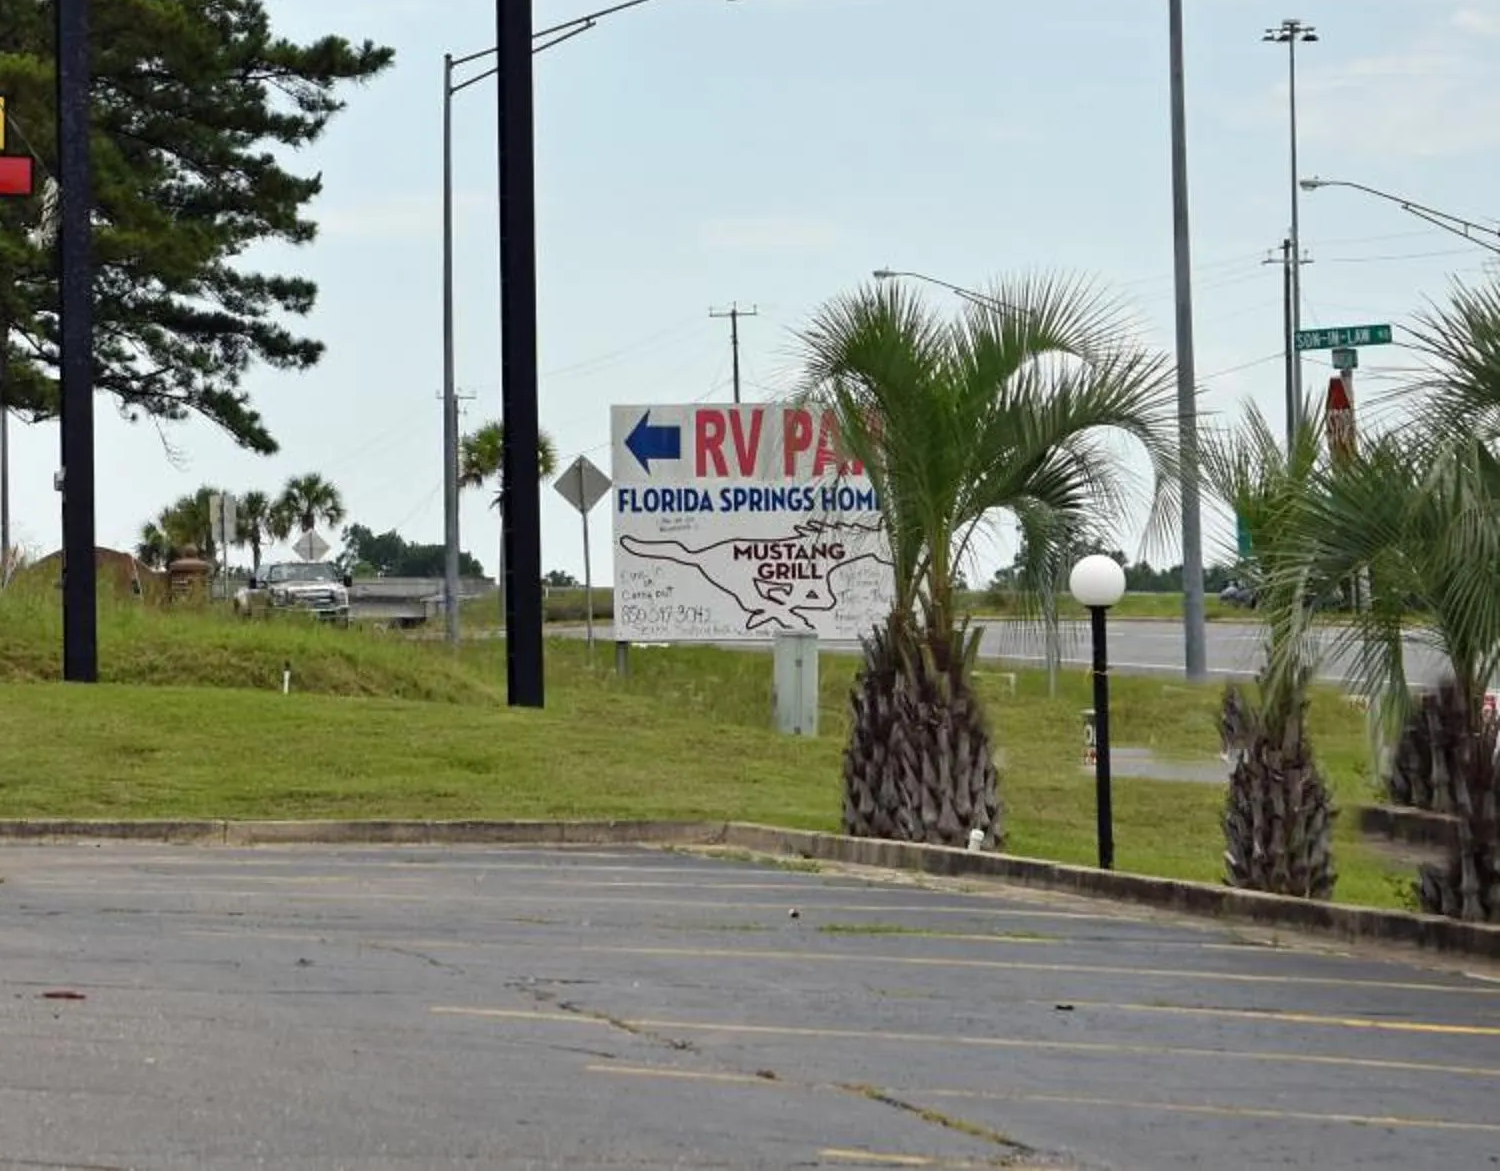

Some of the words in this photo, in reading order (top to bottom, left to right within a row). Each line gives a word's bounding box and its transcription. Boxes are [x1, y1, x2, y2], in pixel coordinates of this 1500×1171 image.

[695, 408, 764, 477] RV
[783, 406, 884, 477] PA
[618, 488, 714, 513] FLORIDA
[720, 487, 815, 513] SPRINGS
[733, 542, 846, 561] MUSTANG
[758, 562, 823, 580] GRILL
